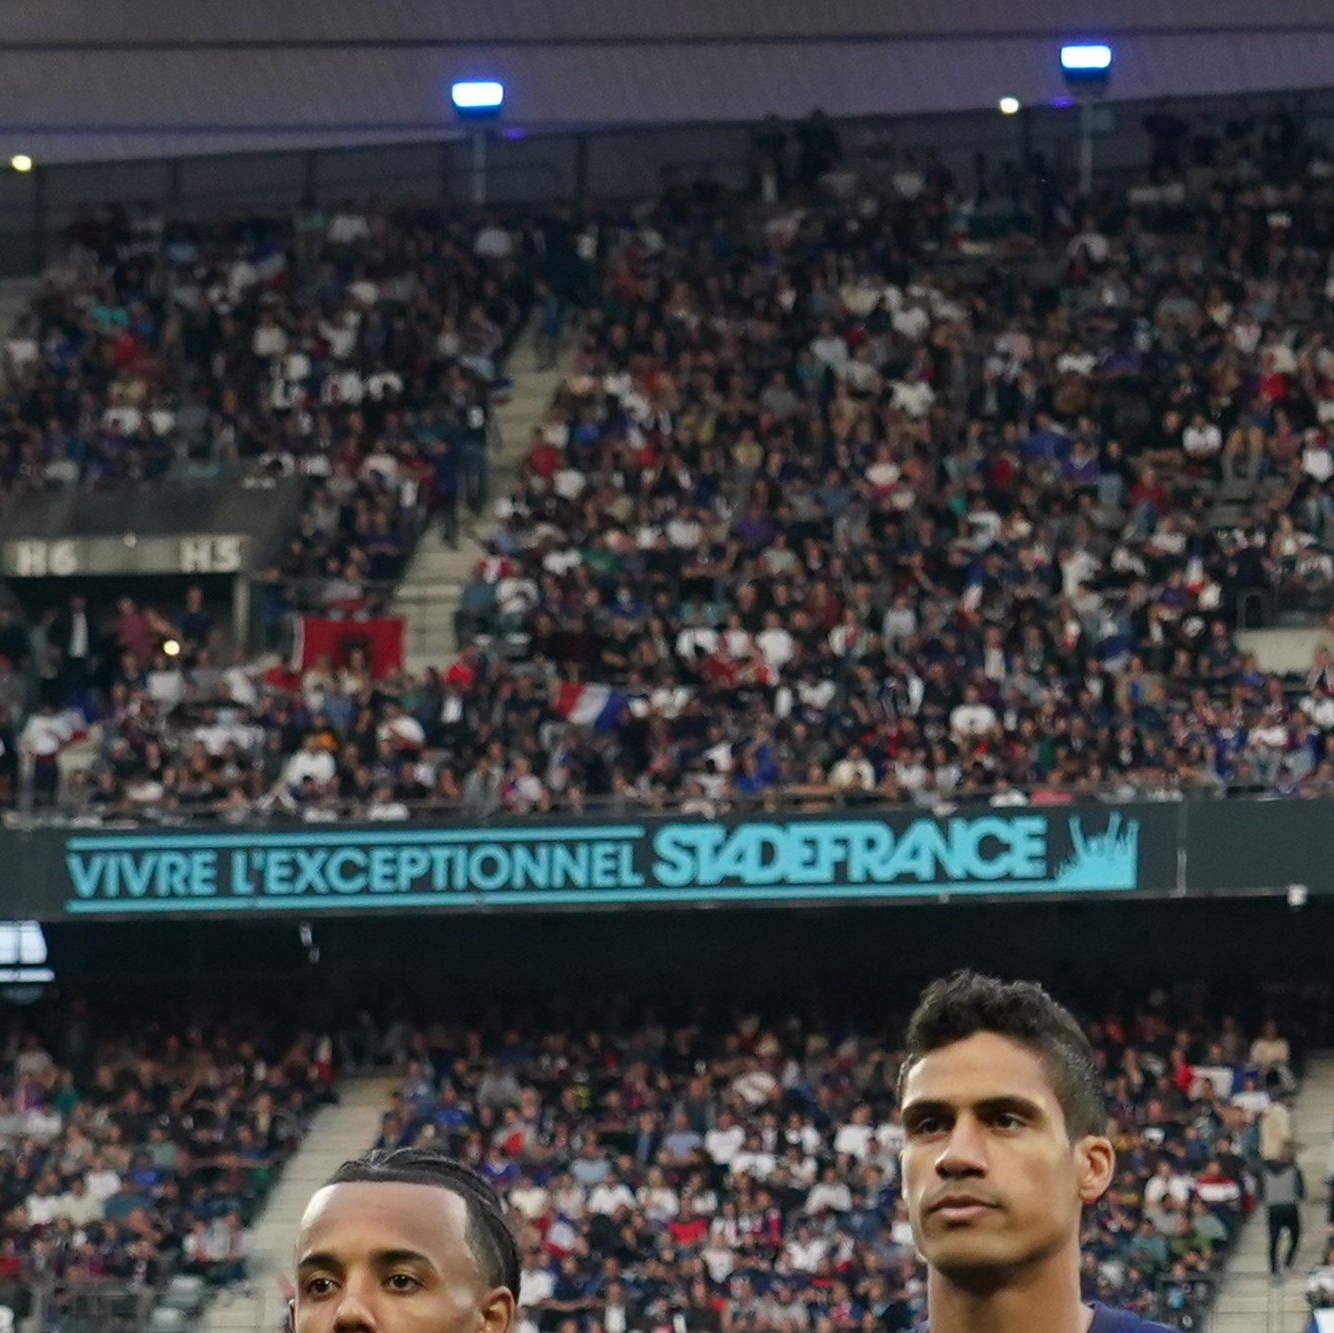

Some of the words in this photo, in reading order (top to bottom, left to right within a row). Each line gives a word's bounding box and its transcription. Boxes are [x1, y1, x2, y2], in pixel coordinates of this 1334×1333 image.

[179, 535, 242, 573] H5
[68, 850, 215, 899] VIVRE
[229, 838, 644, 896] L'EXCEPTIONNEL
